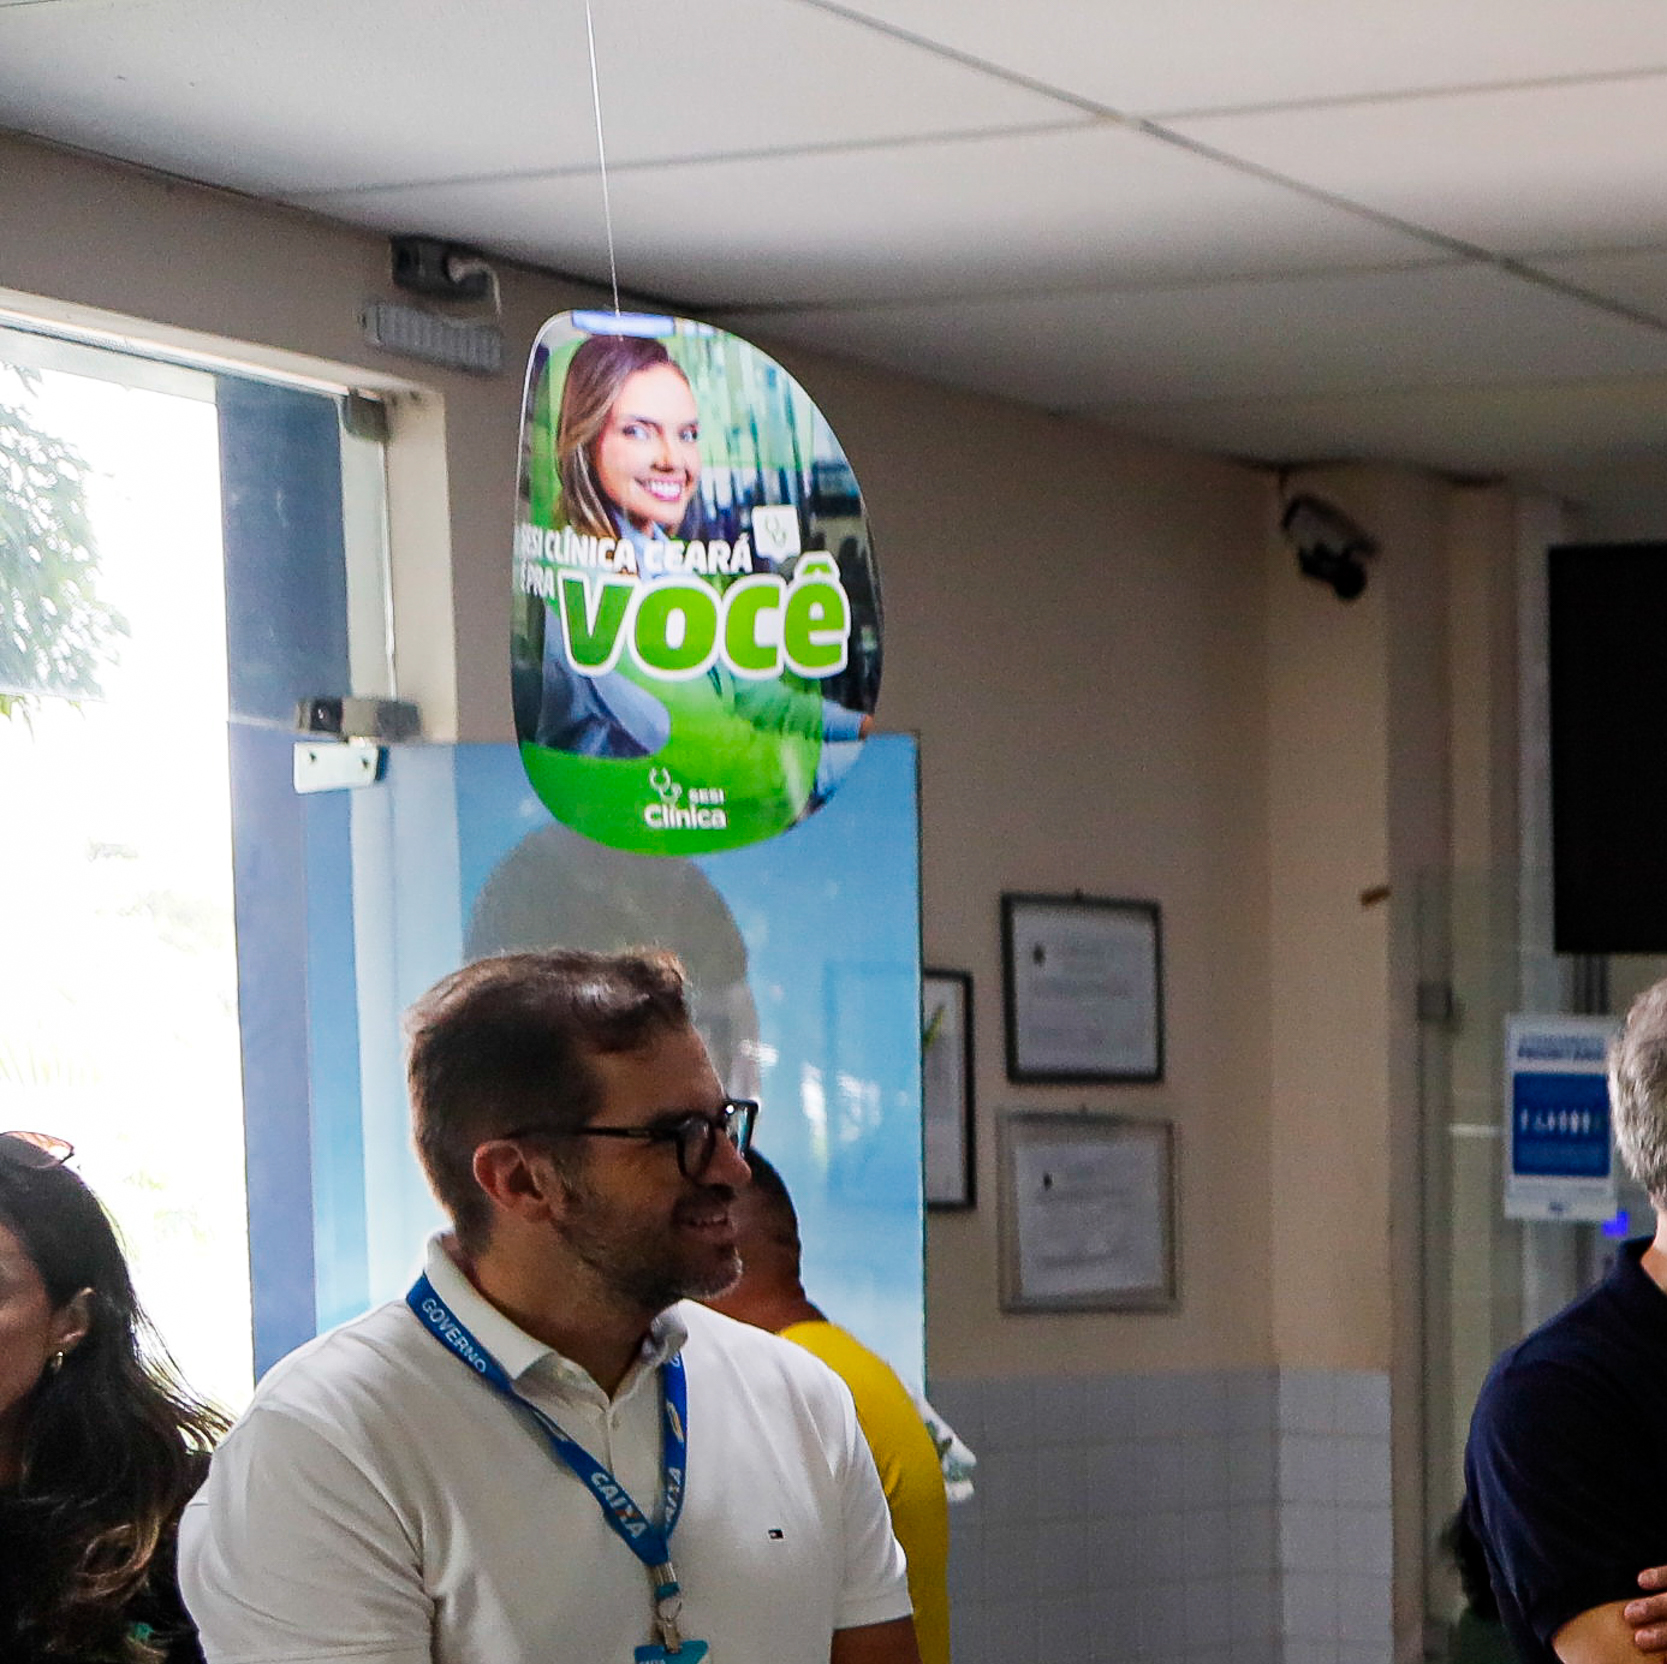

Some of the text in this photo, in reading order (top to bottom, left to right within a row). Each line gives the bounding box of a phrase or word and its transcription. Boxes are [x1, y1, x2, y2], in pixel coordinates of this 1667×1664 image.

[545, 525, 637, 574] CLÍNICA
[643, 532, 753, 575] CEARÁ
[420, 1297, 488, 1375] GOVERNO
[590, 1470, 648, 1540] CAIXA
